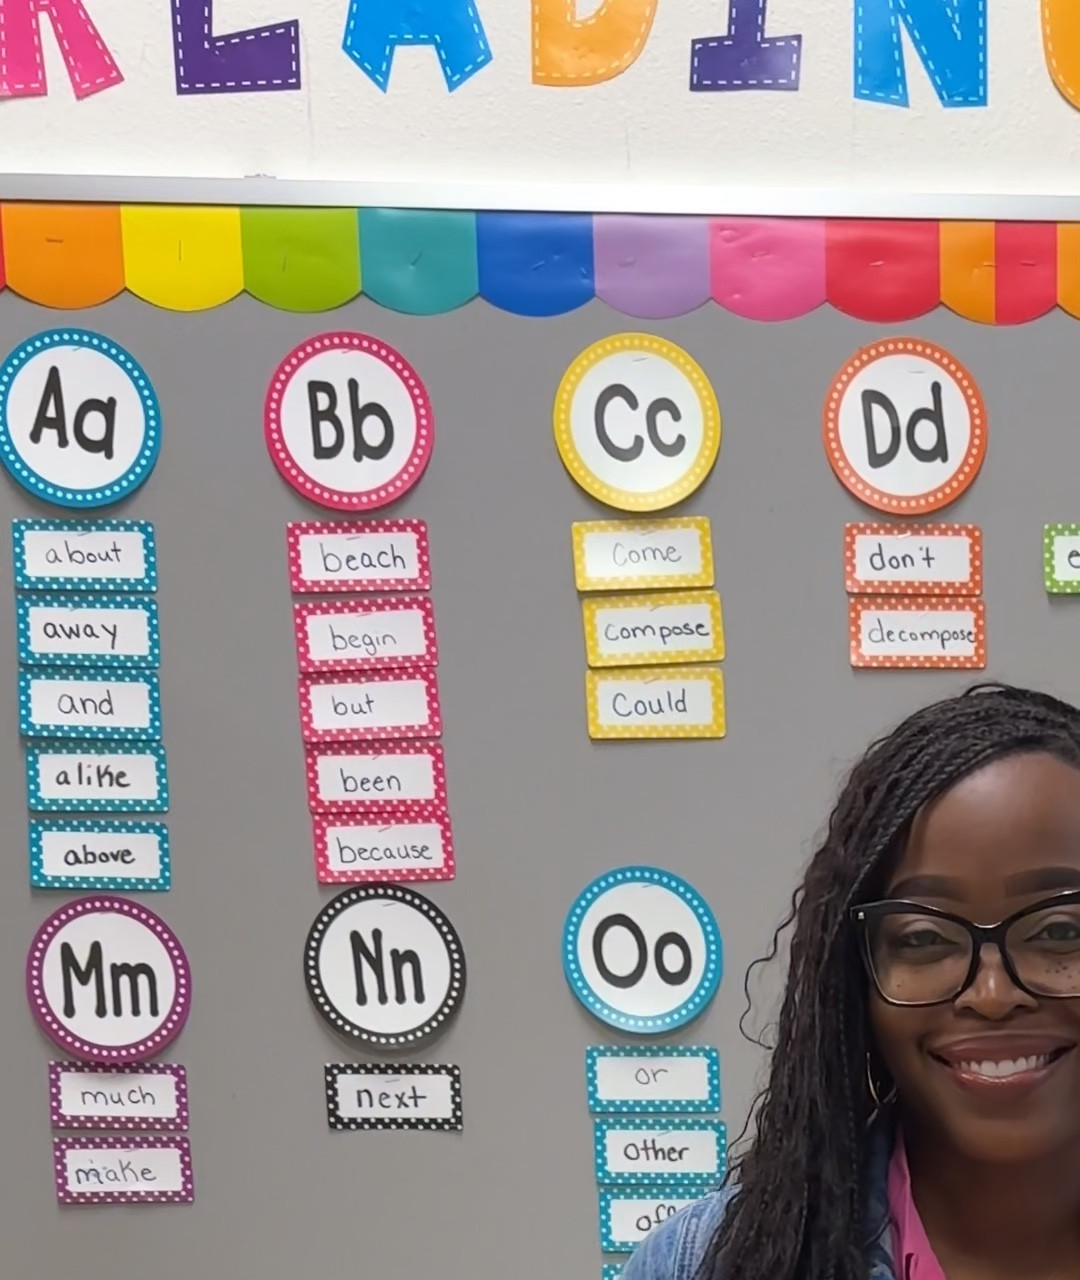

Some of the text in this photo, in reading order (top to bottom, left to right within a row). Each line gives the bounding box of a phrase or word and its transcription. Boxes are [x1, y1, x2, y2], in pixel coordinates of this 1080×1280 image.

[29, 365, 118, 461] Aa
[306, 377, 395, 463] Bb
[594, 383, 686, 463] Cc
[860, 380, 950, 469] Dd
[45, 540, 122, 565] about
[319, 542, 407, 573] beach
[612, 541, 683, 565] Come
[869, 543, 936, 572] don't
[42, 621, 118, 650] away
[330, 624, 397, 656] begin
[868, 619, 975, 650] decompose
[57, 689, 115, 716] and
[331, 692, 375, 717] but
[612, 687, 688, 718] Could
[339, 767, 402, 793] been
[63, 844, 136, 867] above
[335, 836, 433, 864] because
[591, 912, 693, 990] Oo
[60, 940, 160, 1019] Mm
[349, 927, 426, 1007] Nn
[635, 1068, 668, 1085] or
[80, 1084, 156, 1107] much
[356, 1084, 427, 1109] next
